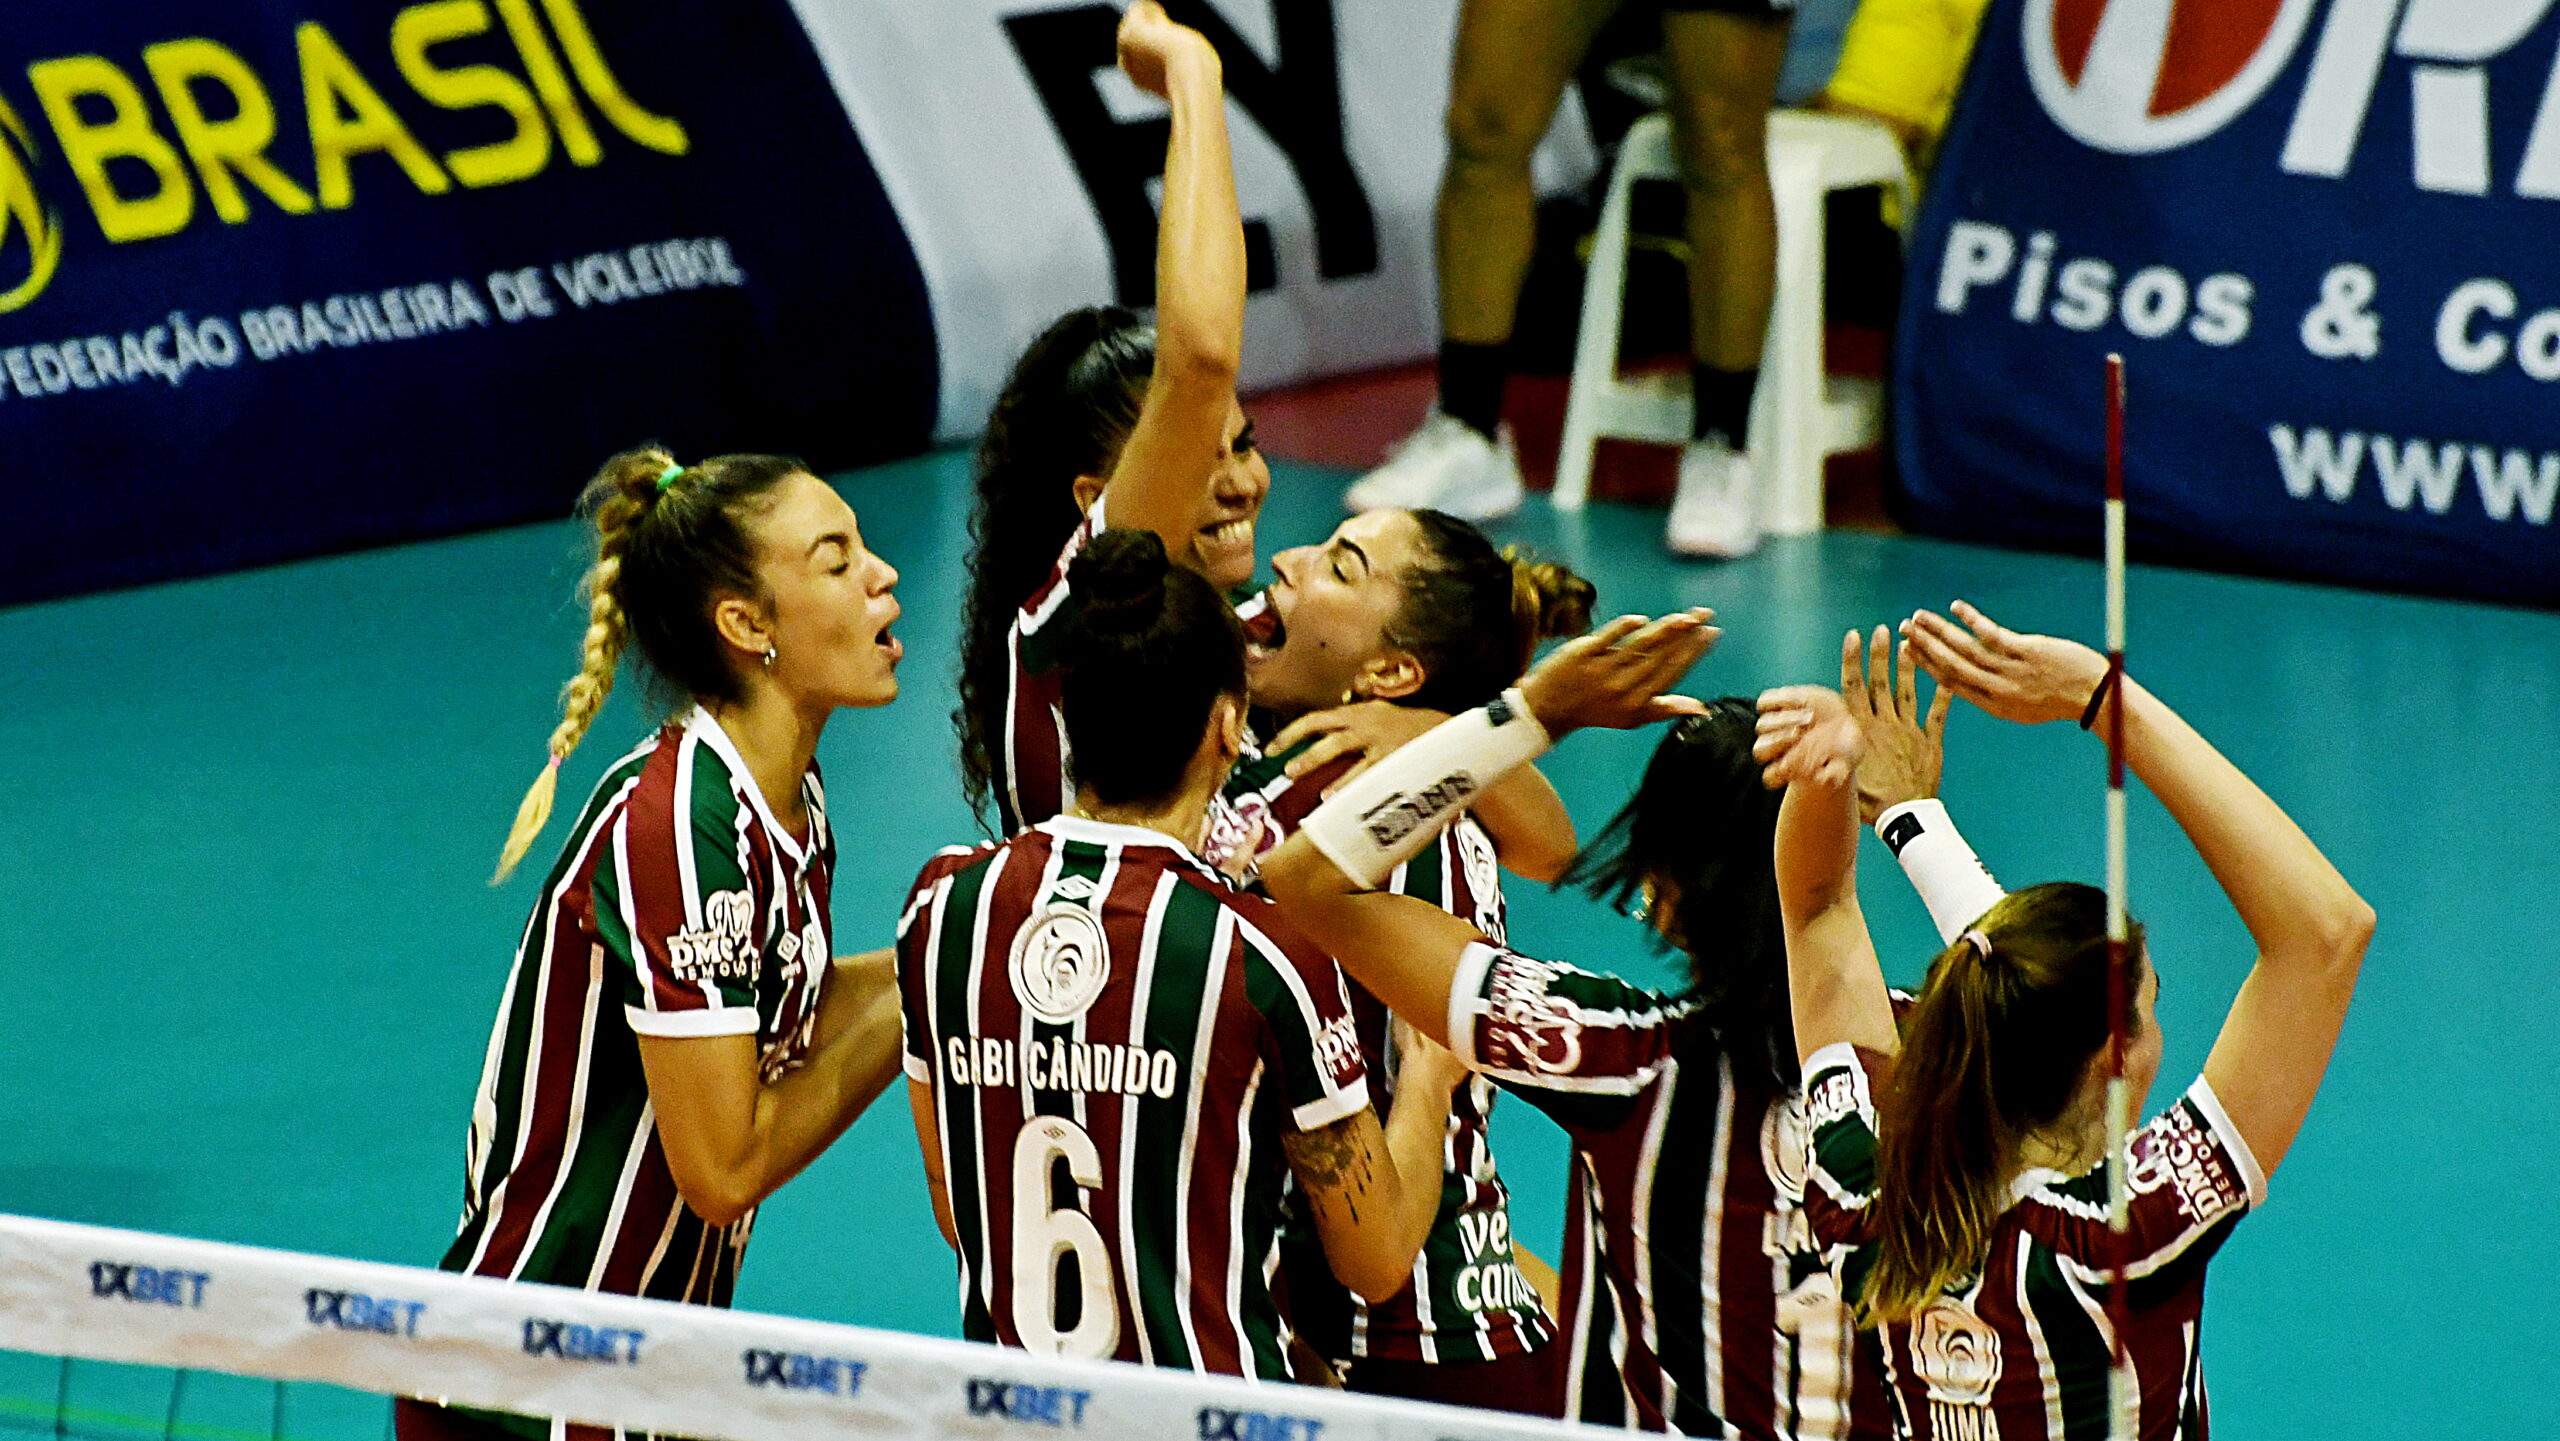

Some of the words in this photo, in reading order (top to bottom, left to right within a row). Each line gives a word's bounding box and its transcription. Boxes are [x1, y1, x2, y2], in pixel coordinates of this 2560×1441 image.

[27, 0, 690, 243] BRASIL
[241, 279, 490, 361] BRASILEIRA
[487, 266, 556, 323] DE
[1935, 220, 2255, 347] Pisos
[2300, 262, 2382, 361] &
[2267, 422, 2560, 526] www
[947, 1036, 1015, 1087] GABI
[1027, 1035, 1177, 1099] CÂNDIDO
[1012, 1115, 1122, 1360] 6
